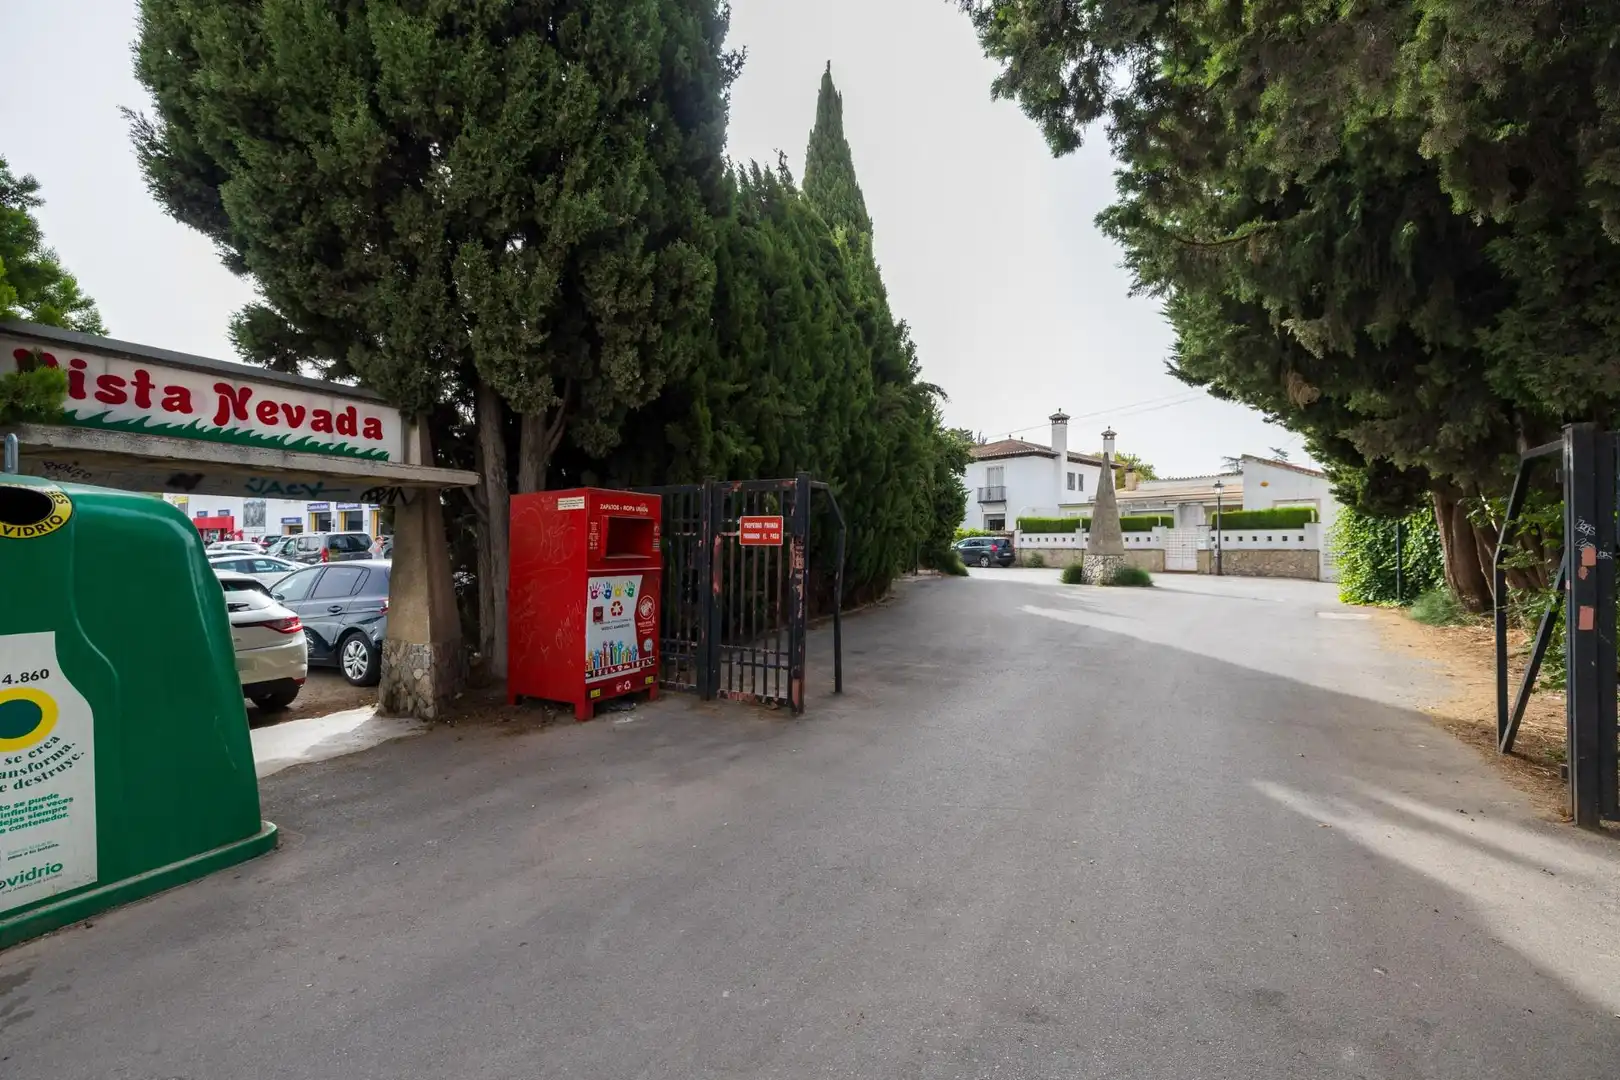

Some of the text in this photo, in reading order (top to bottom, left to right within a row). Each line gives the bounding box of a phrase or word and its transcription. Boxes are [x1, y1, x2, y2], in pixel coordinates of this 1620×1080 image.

[213, 382, 384, 440] Nevada
[2, 515, 63, 537] VIDRIO
[2, 668, 50, 685] 4.860
[4, 735, 61, 765] se crea
[13, 752, 85, 790] destruye.
[0, 797, 74, 818] infinitas veces
[28, 793, 60, 806] puede
[9, 812, 70, 832] contenedor.
[28, 805, 68, 819] siempre
